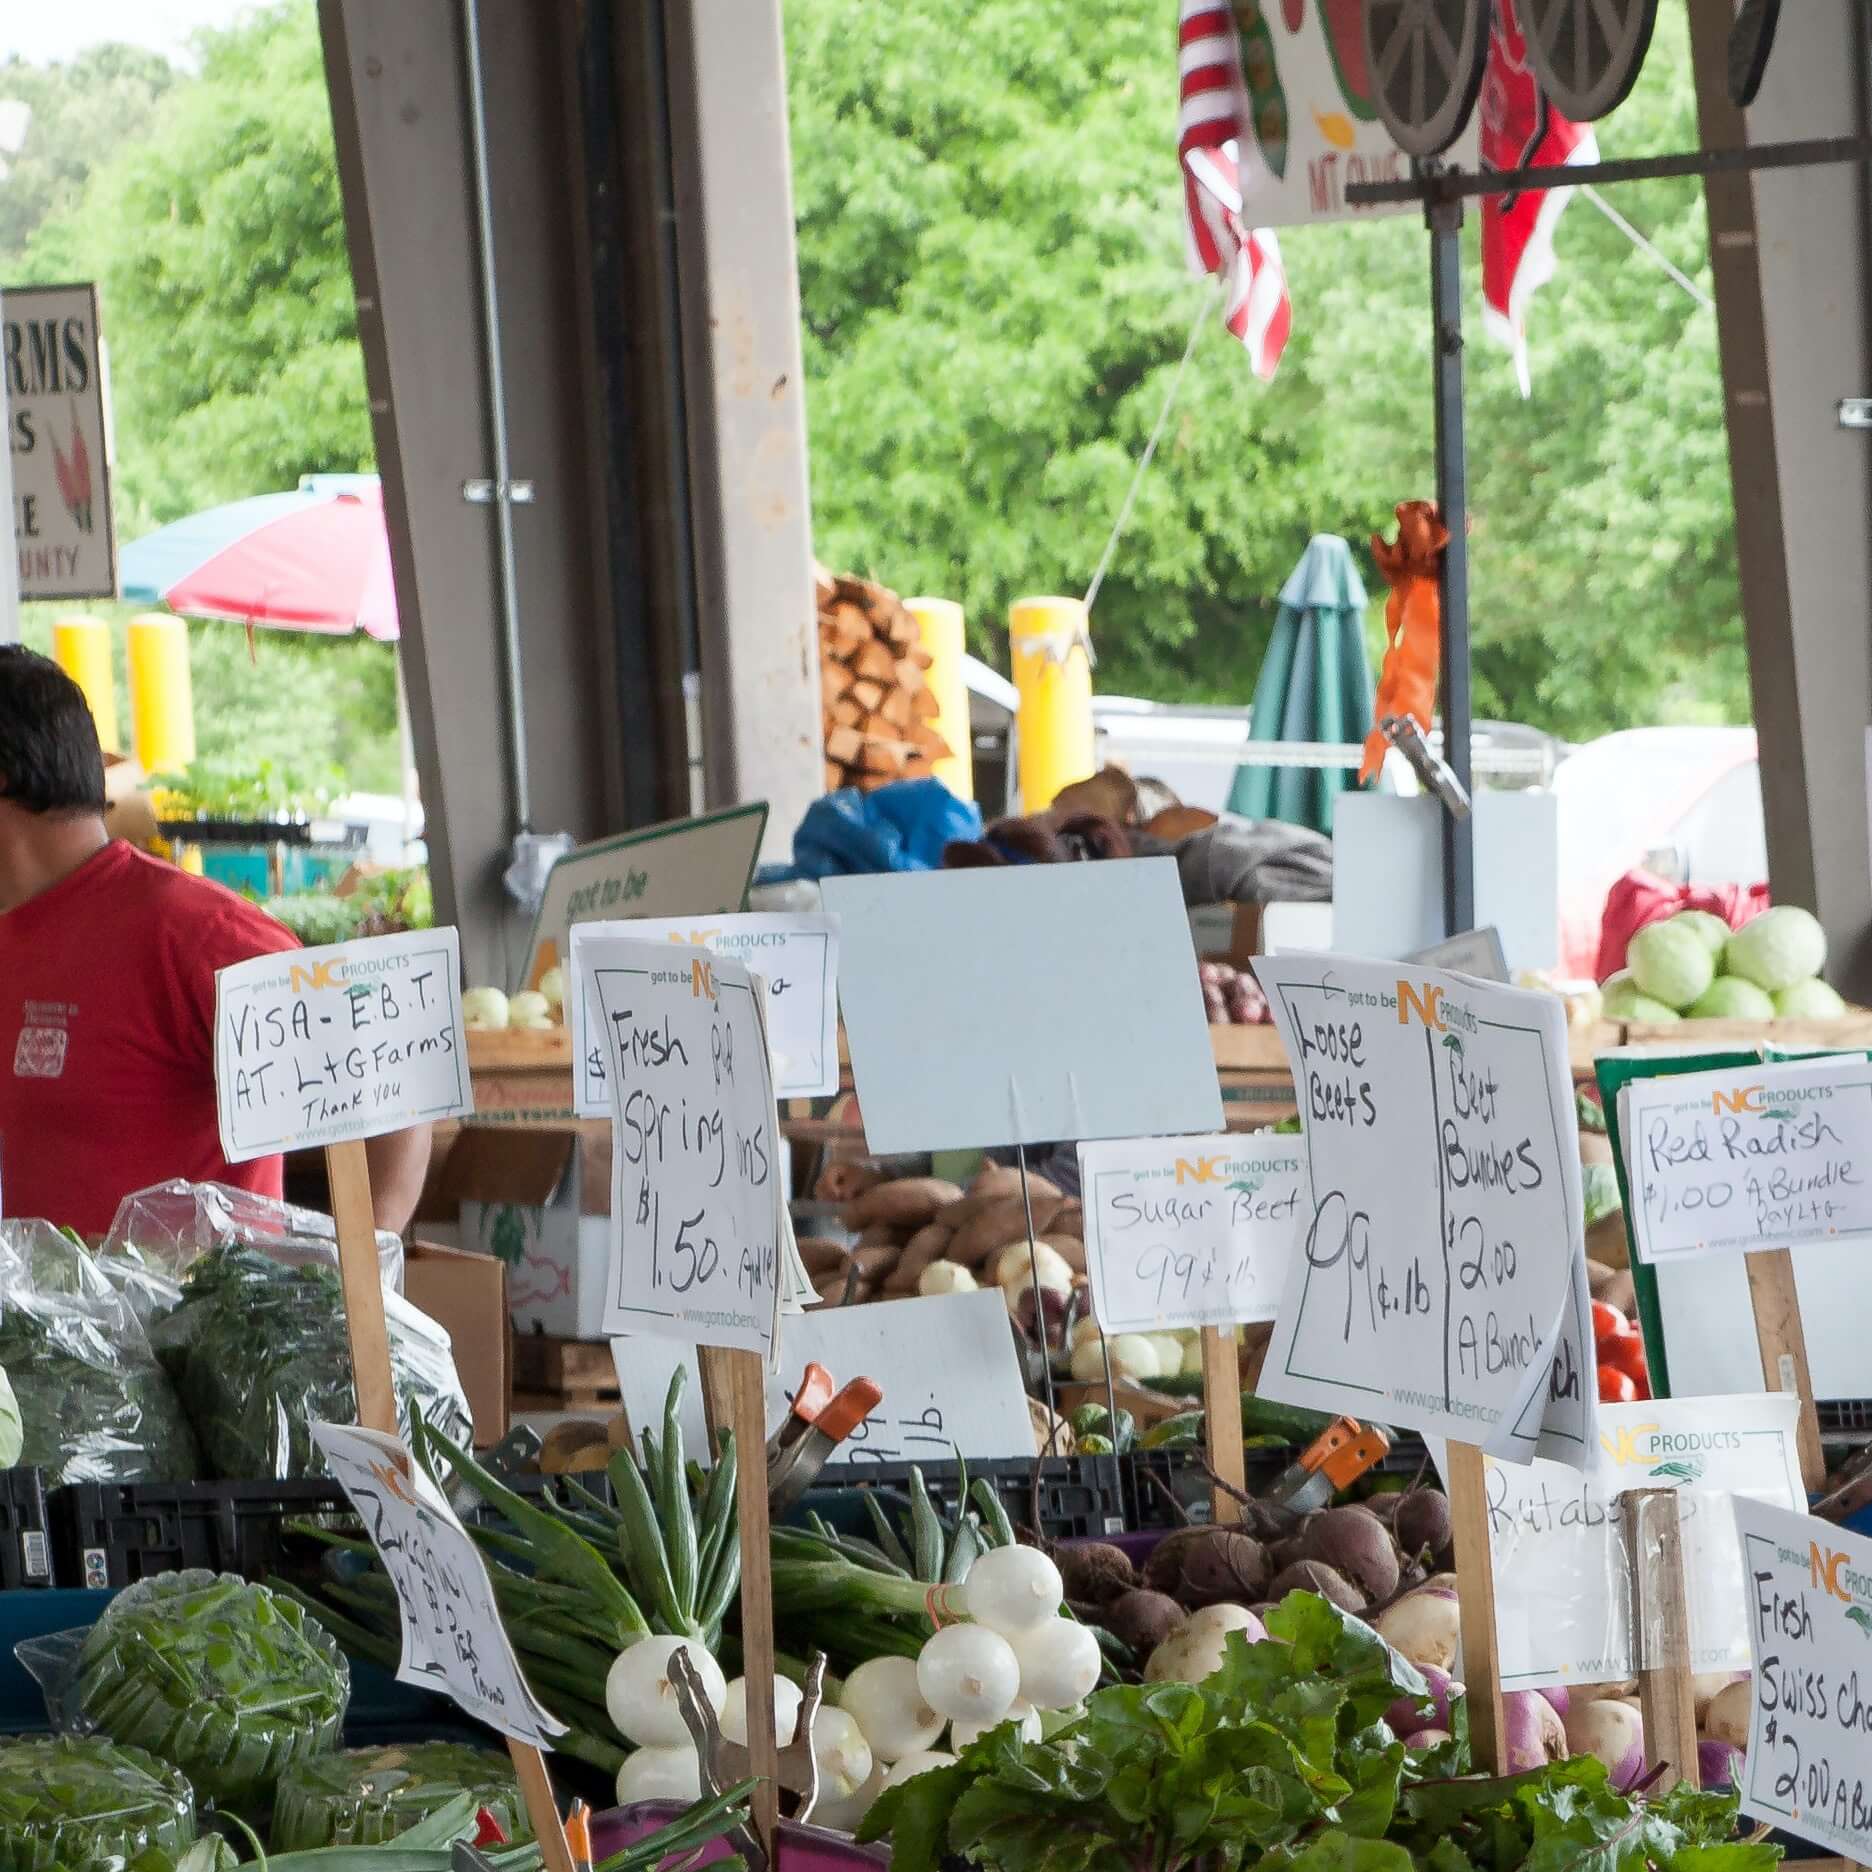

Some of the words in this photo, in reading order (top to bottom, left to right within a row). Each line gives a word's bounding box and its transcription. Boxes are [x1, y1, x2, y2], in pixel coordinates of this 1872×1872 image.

[716, 932, 787, 949] PRODUCTS
[288, 957, 352, 993] NC
[340, 954, 410, 980] PRODUCTS
[651, 970, 668, 985] got
[668, 971, 679, 984] to
[680, 969, 692, 984] be
[1347, 991, 1365, 1009] got
[1366, 992, 1378, 1008] to
[1380, 990, 1398, 1009] be
[1397, 979, 1448, 1033] NC
[611, 1009, 689, 1080] Fresh
[1293, 1002, 1368, 1068] Loose
[1310, 1070, 1378, 1128] Beets
[1449, 1048, 1499, 1125] Beet
[1711, 1084, 1767, 1116] NC
[1757, 1086, 1833, 1105] PRODUCTS
[1720, 1111, 1843, 1161] Radish
[1174, 1154, 1233, 1186] NC
[1224, 1158, 1299, 1175] PRODUCTS
[1768, 1158, 1864, 1203] Bundle
[1111, 1193, 1213, 1231] Sugar
[1232, 1187, 1301, 1227] Beet
[1649, 1431, 1741, 1454] PRODUCTS
[1808, 1539, 1853, 1604] NC
[1753, 1571, 1815, 1645] Fresh
[1758, 1655, 1828, 1720] Swiss
